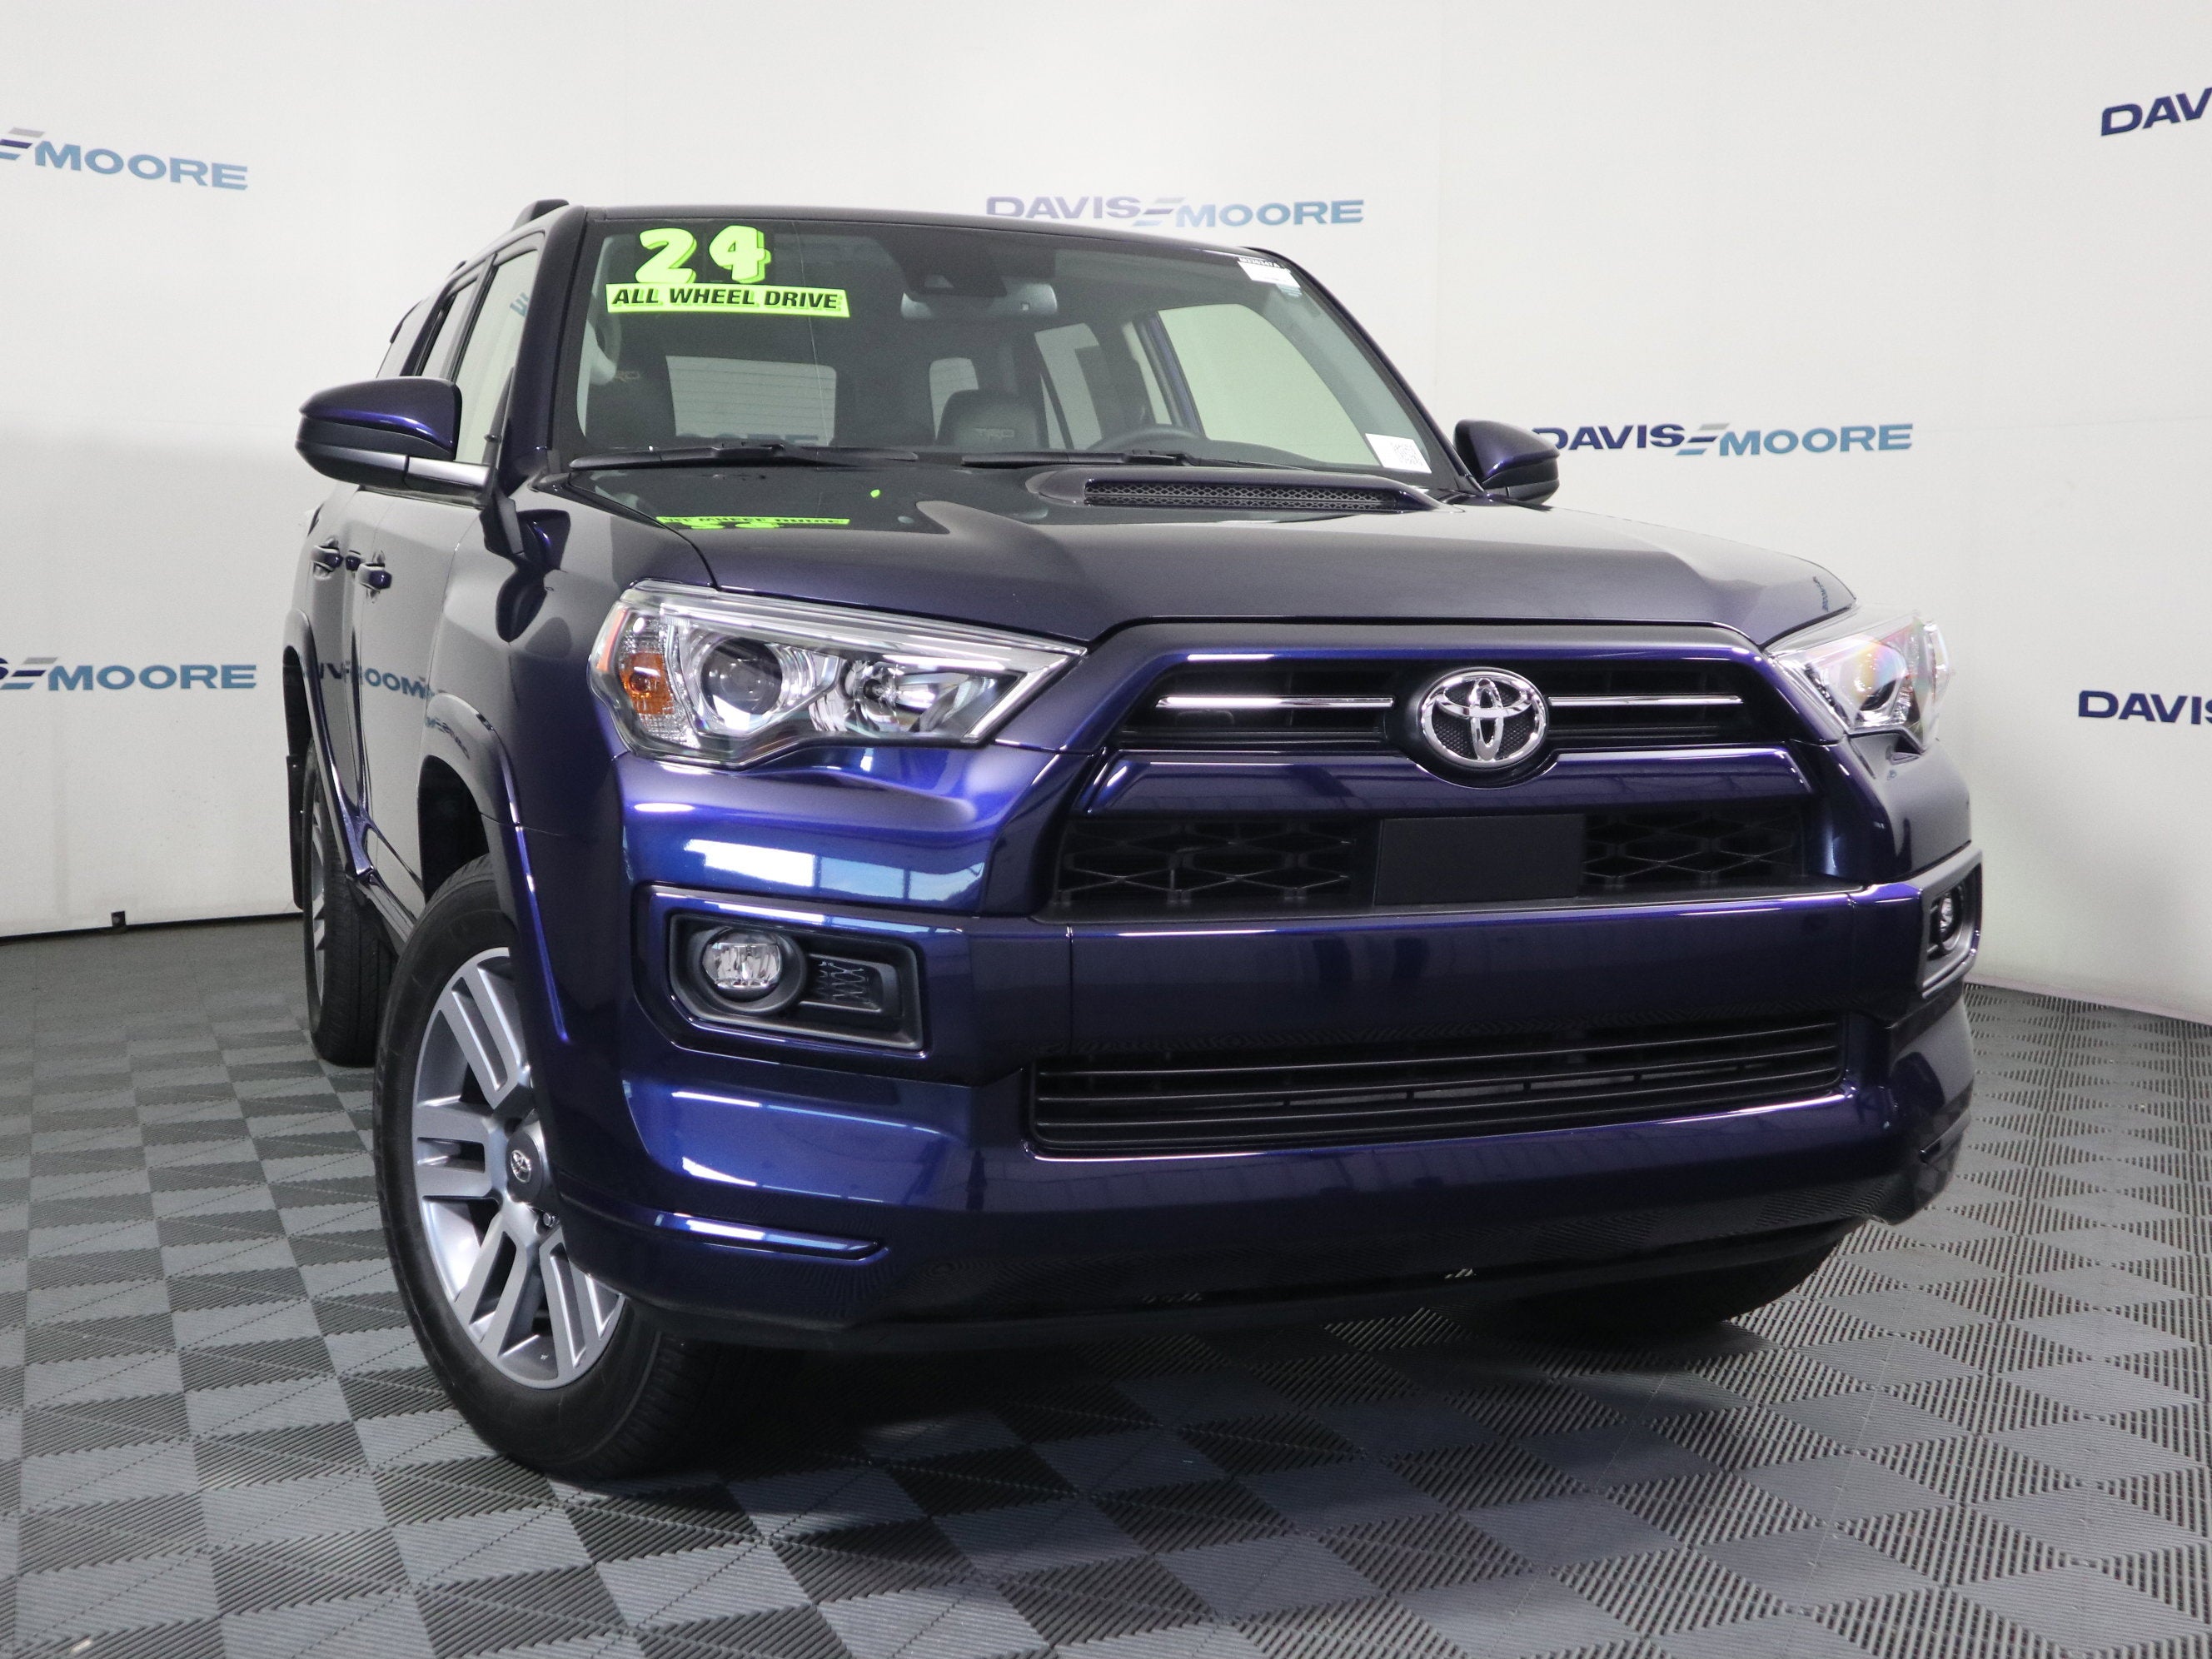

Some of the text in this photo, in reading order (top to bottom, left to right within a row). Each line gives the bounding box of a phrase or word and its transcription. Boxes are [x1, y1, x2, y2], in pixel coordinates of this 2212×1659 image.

[34, 140, 248, 191] MOORE
[986, 196, 1365, 228] DAVIS MOORE
[635, 225, 772, 284] 24
[612, 288, 839, 310] ALL WHEEL DRIVE
[1719, 423, 1914, 456] MOORE
[47, 665, 257, 691] MOORE
